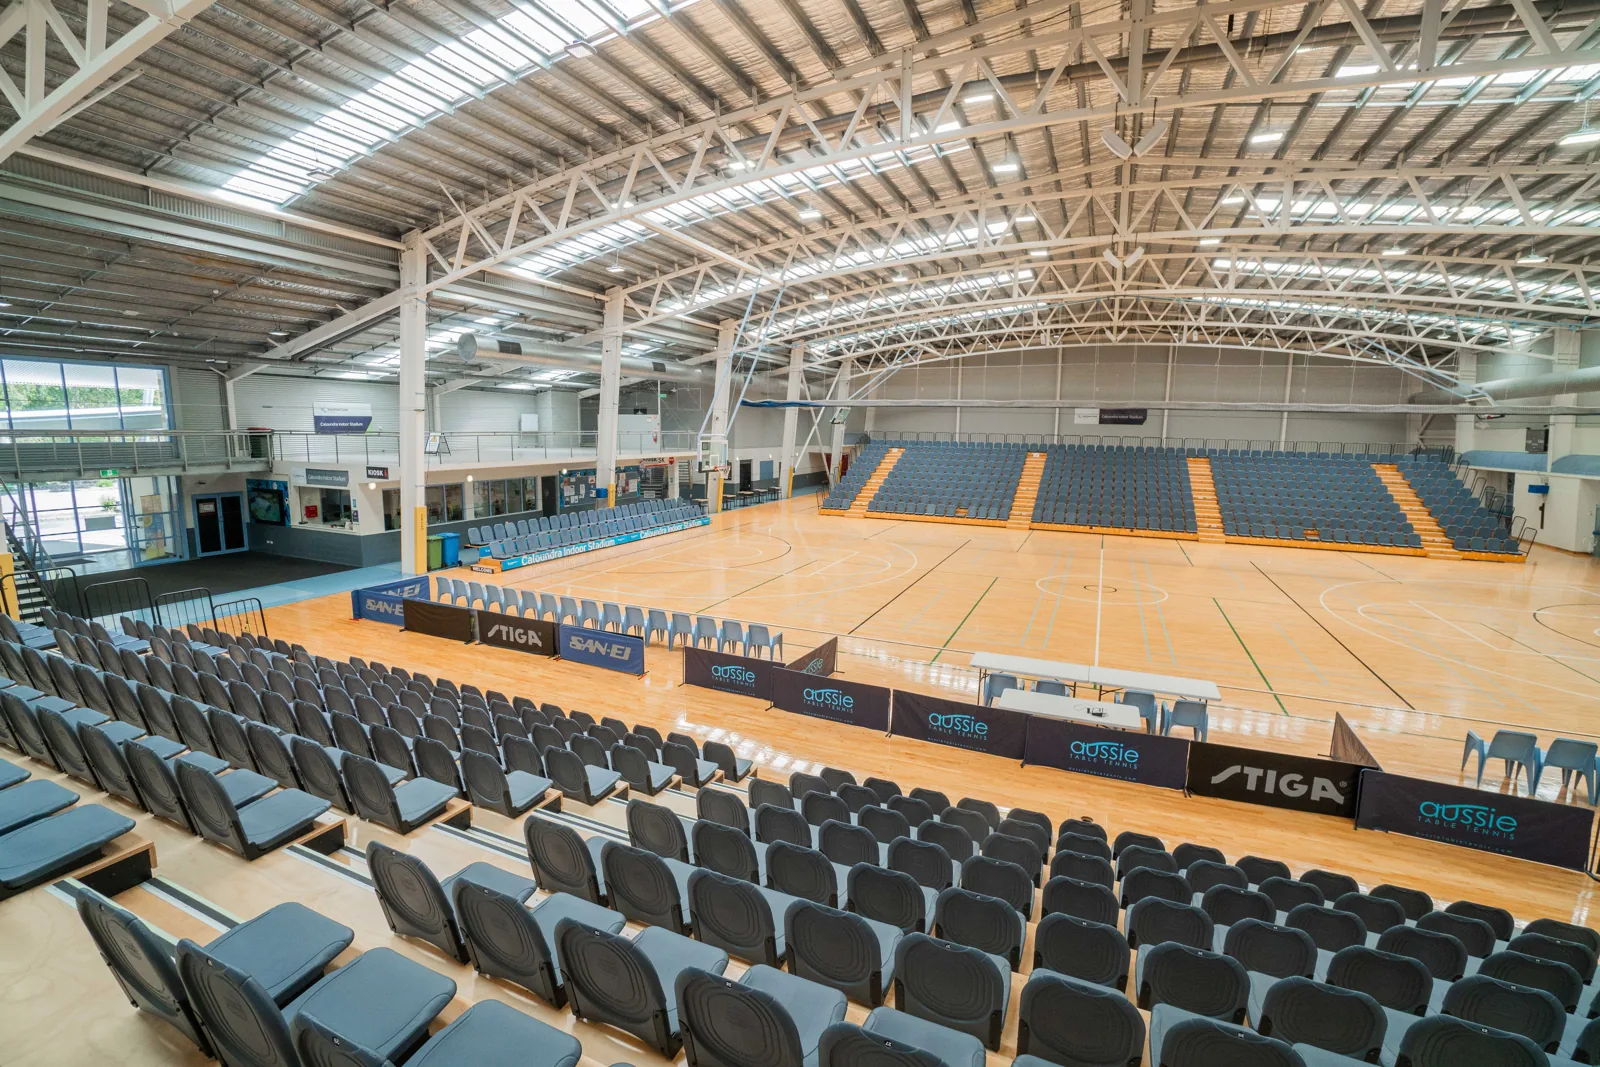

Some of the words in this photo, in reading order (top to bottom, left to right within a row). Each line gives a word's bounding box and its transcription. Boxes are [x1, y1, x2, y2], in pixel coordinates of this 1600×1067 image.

[368, 469, 384, 477] KIOSK
[640, 526, 668, 539] Caloundra
[668, 524, 683, 533] Indoor
[683, 519, 703, 529] Stadium
[521, 548, 562, 566] Caloundra
[563, 544, 587, 557] Indoor
[588, 539, 615, 551] Stadium
[472, 566, 493, 574] WELCOME
[569, 635, 631, 661] SAN-EI
[711, 665, 756, 682] aussie
[803, 688, 854, 708] aussie
[803, 699, 824, 708] TABLE
[828, 704, 854, 714] TENNIS
[928, 713, 988, 735] aussie
[928, 724, 952, 735] TABLE
[957, 731, 987, 741] TENNIS
[1069, 753, 1097, 763] TABLE
[1103, 760, 1138, 770] TENNIS
[1070, 741, 1139, 763] aussie
[1420, 801, 1518, 832] aussie
[1418, 816, 1457, 829] TABLE
[1466, 825, 1515, 841] TENNIS
